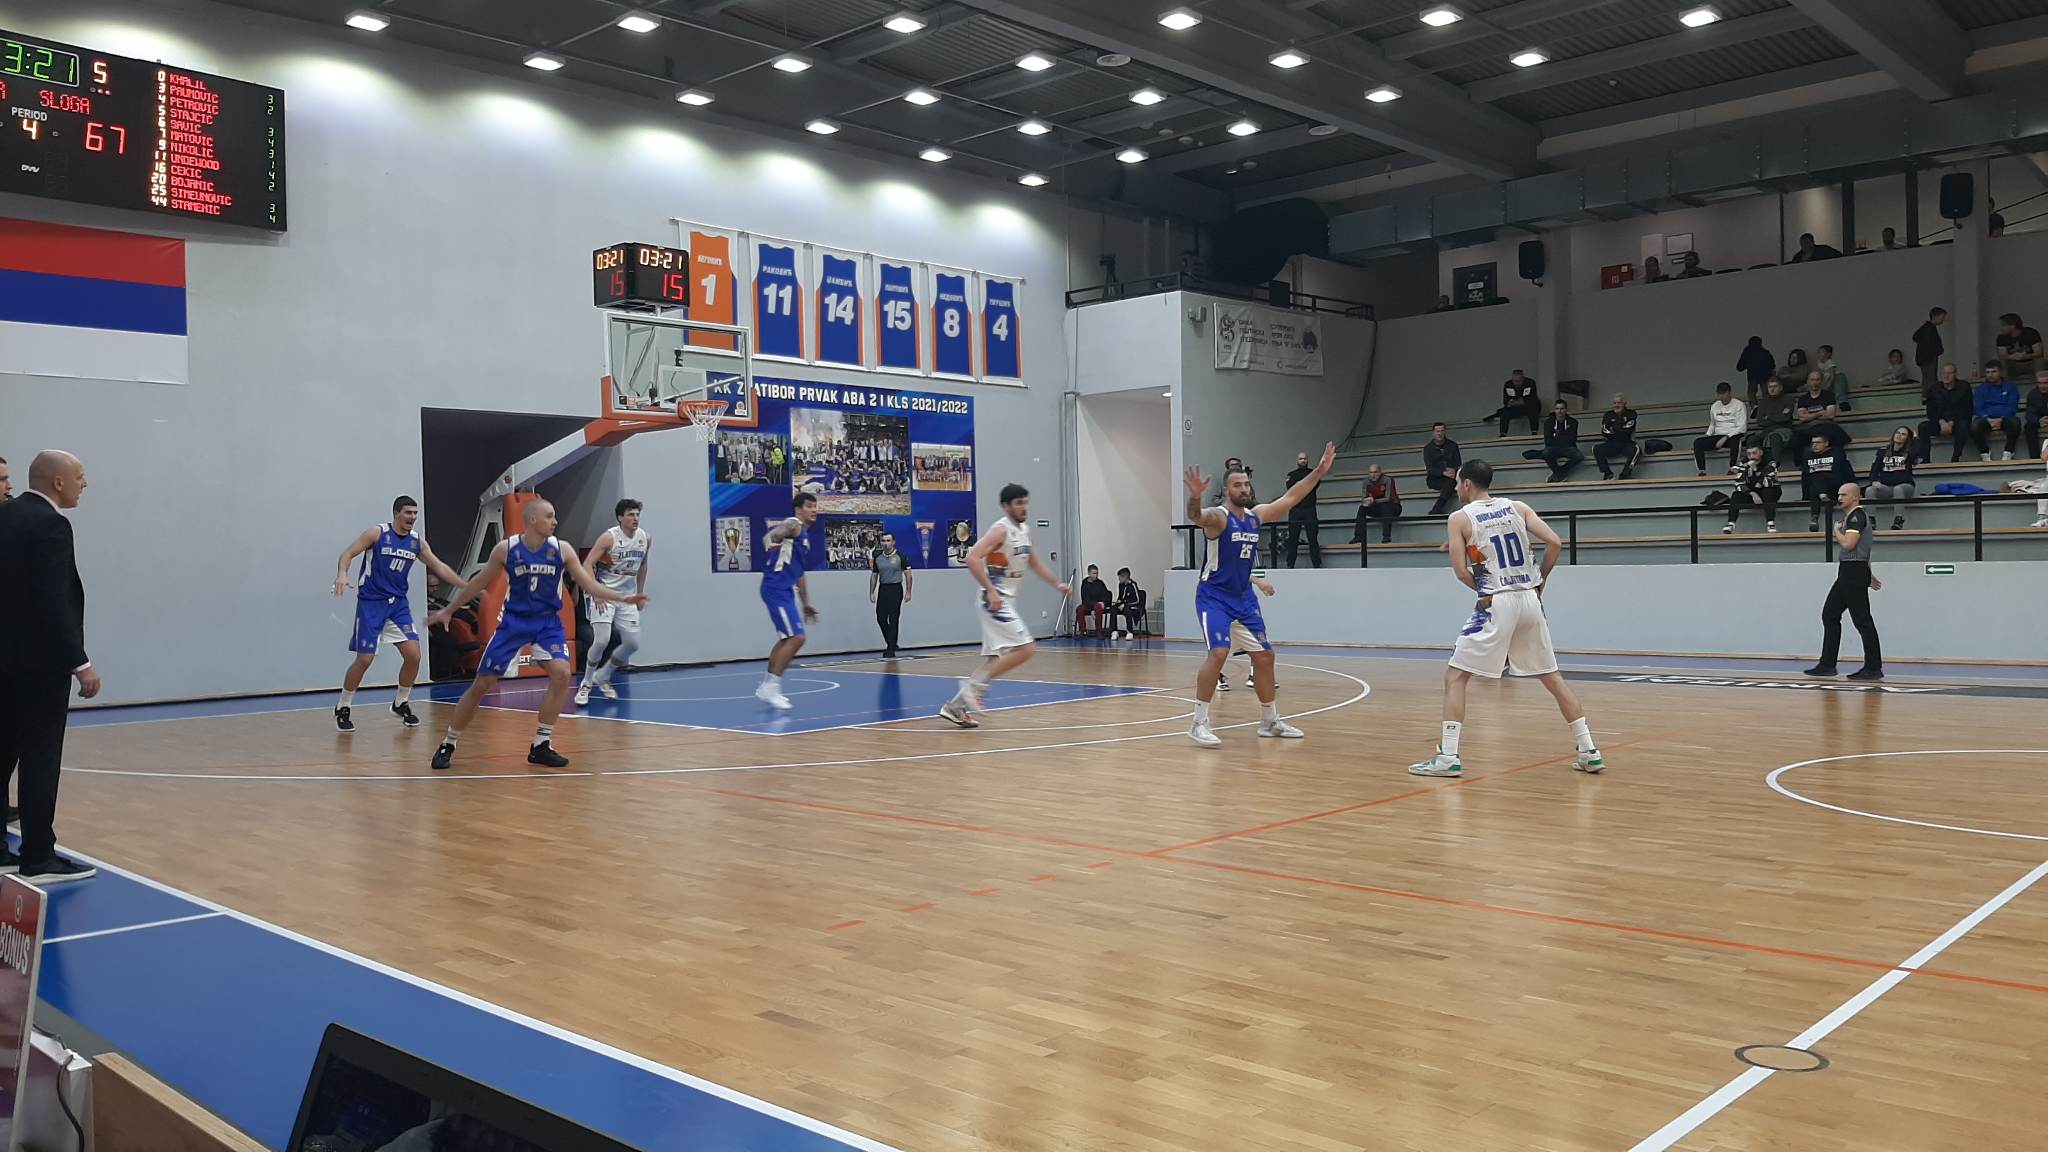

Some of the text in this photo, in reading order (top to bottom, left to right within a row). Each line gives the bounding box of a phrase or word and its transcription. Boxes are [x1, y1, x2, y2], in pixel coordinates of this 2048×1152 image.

[94, 62, 107, 83] 5
[158, 71, 274, 104] 0 KHALIL 3
[158, 83, 165, 93] 3
[268, 106, 274, 115] 2
[12, 107, 47, 121] PERIOD
[40, 90, 90, 114] SLOGA
[169, 97, 219, 114] PETROVIC
[23, 119, 38, 140] 4
[158, 116, 274, 148] 6 SAVIC 4
[159, 105, 274, 136] 5 STAJCIC 3
[86, 122, 125, 154] 67
[159, 140, 166, 150] 9
[170, 142, 214, 158] NIKOLIC
[160, 128, 274, 158] 7 MATOVIC 3
[151, 172, 166, 184] 20
[155, 150, 166, 160] 11
[269, 170, 275, 180] 4
[155, 162, 275, 191] 16 CEKIC 2
[151, 184, 276, 212] 25 SIMEUNOVIC 3
[151, 196, 276, 224] 44 STAMENIC 4
[596, 249, 624, 270] 03:21
[640, 249, 683, 270] 03:21
[663, 272, 685, 300] 15
[701, 273, 717, 306] 1
[763, 283, 793, 316] 11
[824, 292, 855, 326] 14
[883, 300, 912, 331] 15
[943, 308, 960, 338] 8
[992, 314, 1009, 342] 4
[737, 381, 796, 401] ZATIBOR
[799, 387, 839, 404] PRVAK
[842, 391, 866, 407] ABA
[869, 394, 877, 407] 2
[887, 395, 909, 410] KLS
[911, 397, 968, 414] 2021/2022
[380, 547, 417, 561] SLOGA
[1240, 543, 1253, 559] 25
[1489, 531, 1525, 570] 10
[389, 558, 406, 572] 44
[514, 564, 556, 576] SLOGA
[530, 576, 539, 592] 3
[0, 921, 31, 975] BONUS
